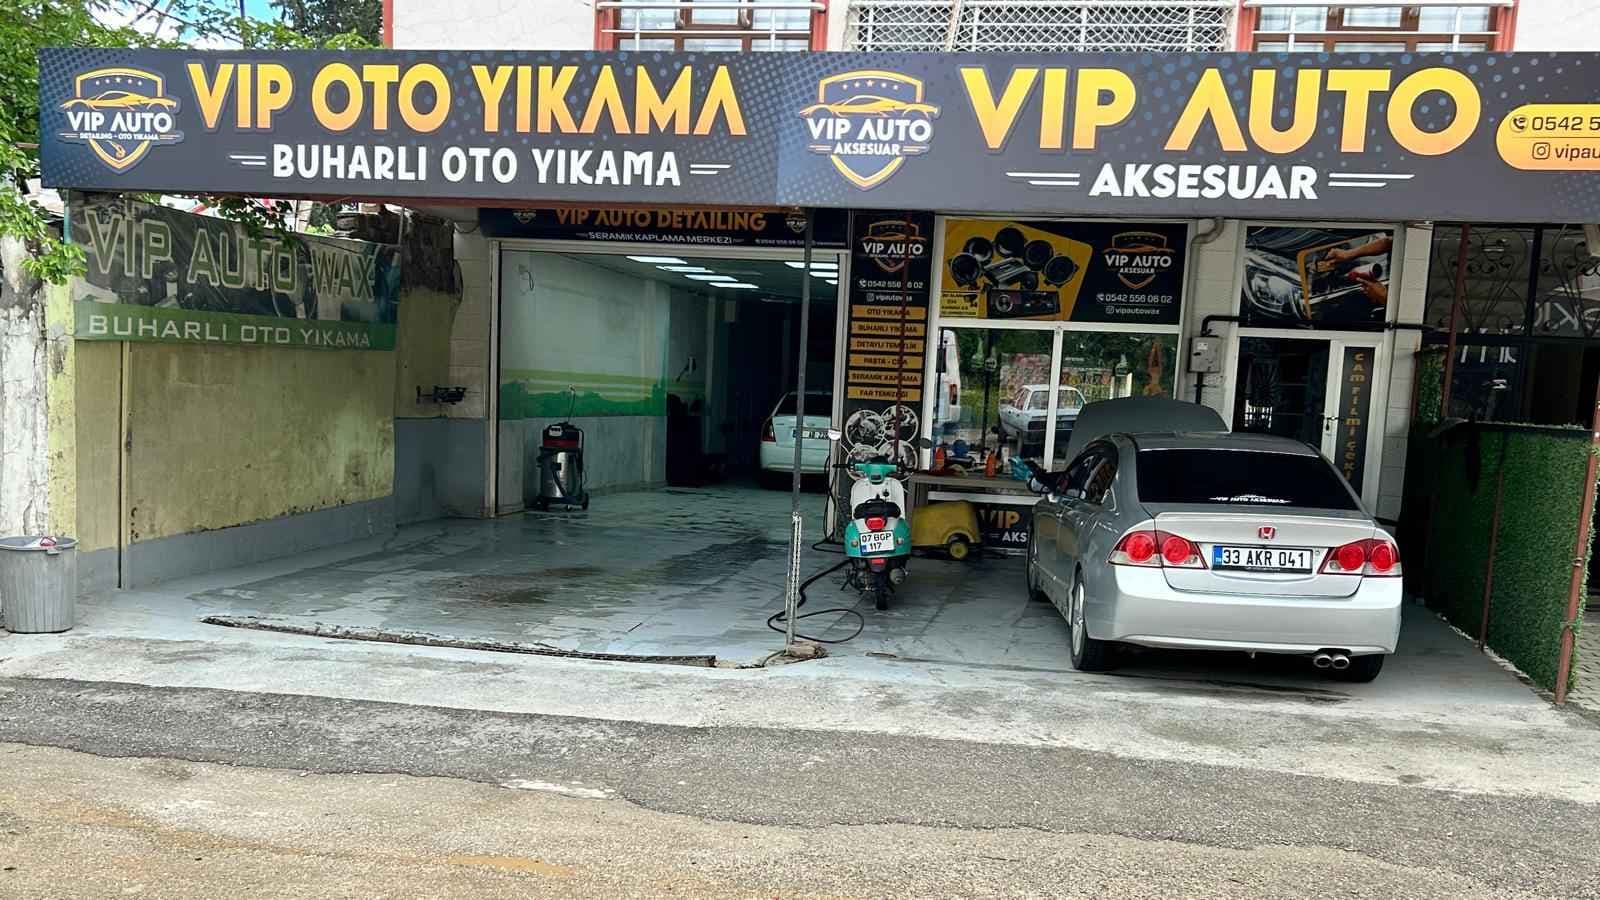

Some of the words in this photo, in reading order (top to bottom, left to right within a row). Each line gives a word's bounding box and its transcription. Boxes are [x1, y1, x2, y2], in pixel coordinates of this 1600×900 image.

[187, 63, 293, 129] VIP
[311, 62, 451, 133] OTO
[471, 65, 747, 136] YIKAMA
[960, 68, 1136, 149] VIP
[1164, 67, 1481, 156] AUTO
[67, 112, 105, 131] VIP
[110, 112, 172, 133] AUTO
[808, 118, 850, 140] VIP
[857, 118, 931, 142] AUTO
[1532, 116, 1583, 131] 0542
[833, 142, 900, 155] AKSESUAR
[1555, 144, 1600, 161] vipau
[272, 144, 427, 181] BUHARLI
[442, 146, 517, 184] OTO
[532, 148, 681, 186] YIKAMA
[1088, 163, 1318, 200] AKSESUAR
[555, 208, 589, 224] VIP
[595, 209, 651, 228] AUTO
[657, 210, 767, 231] DETAILING
[635, 232, 686, 243] KAPLAMA
[85, 210, 173, 279] VIP
[187, 228, 298, 295] AUTO
[311, 248, 375, 301] WAX
[863, 242, 885, 254] VIP
[1104, 254, 1128, 266] VIP
[1132, 254, 1172, 267] AUTO
[1119, 267, 1155, 275] AKSESUAR
[1105, 294, 1128, 302] 0542
[1160, 295, 1172, 304] 02
[88, 314, 228, 342] BUHARLI
[240, 325, 290, 344] OTO
[300, 328, 370, 348] YIKAMA
[861, 534, 872, 543] 07
[1001, 531, 1027, 543] AKS
[1223, 549, 1240, 564] 33
[1246, 550, 1273, 566] AKR
[1278, 551, 1304, 567] 041
